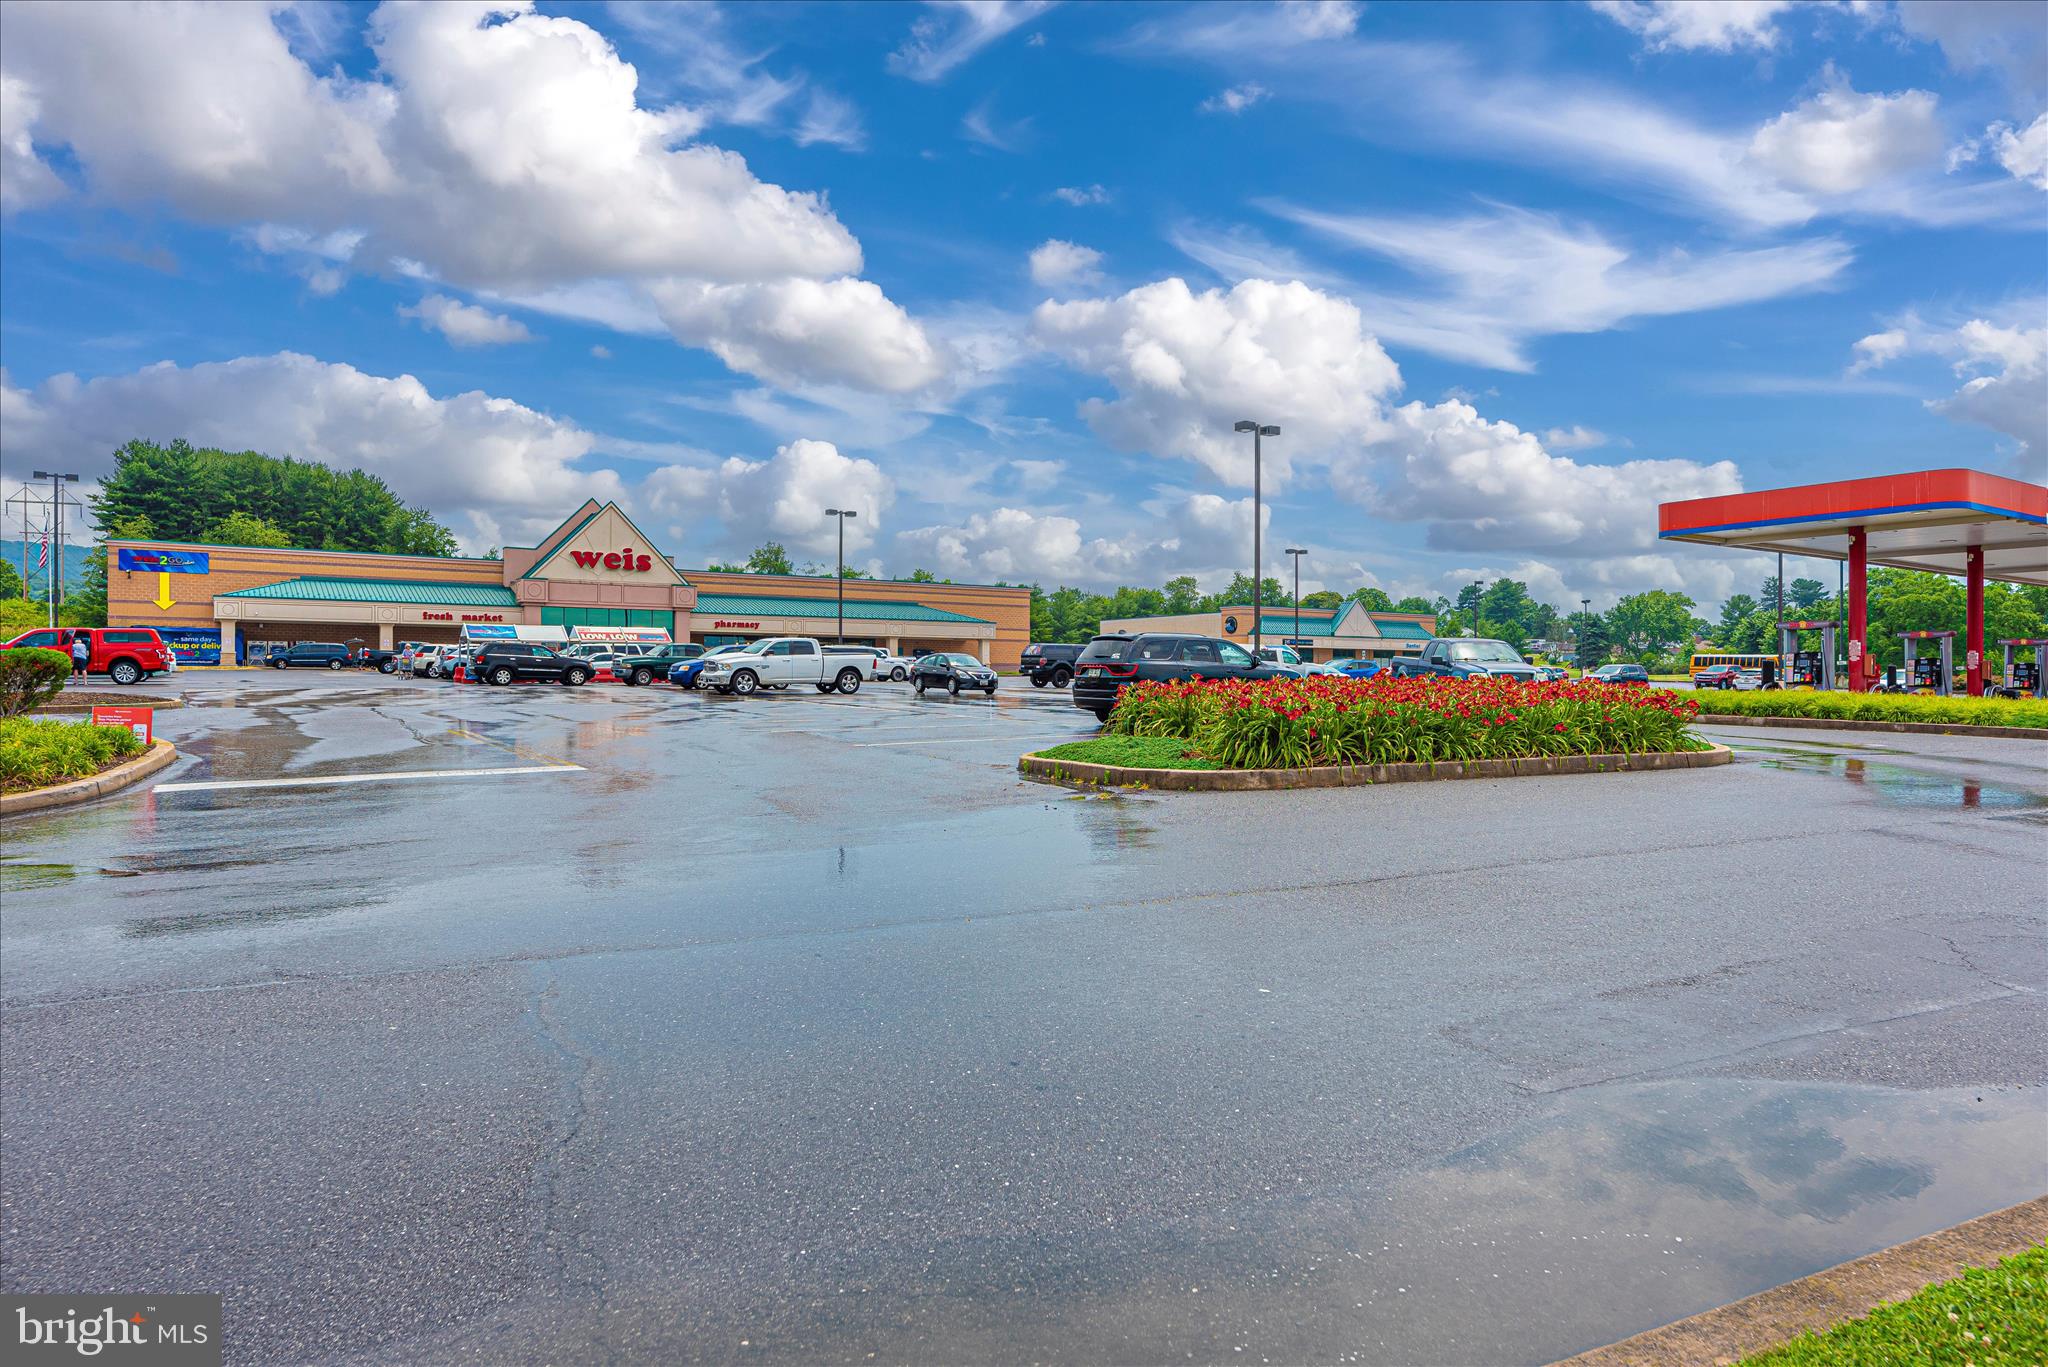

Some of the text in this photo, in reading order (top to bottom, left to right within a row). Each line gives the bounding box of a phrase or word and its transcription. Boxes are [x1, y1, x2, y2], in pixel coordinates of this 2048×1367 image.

[569, 547, 652, 572] weis
[422, 611, 503, 622] fresh market
[714, 620, 760, 630] pharmacy
[169, 642, 189, 650] ckup
